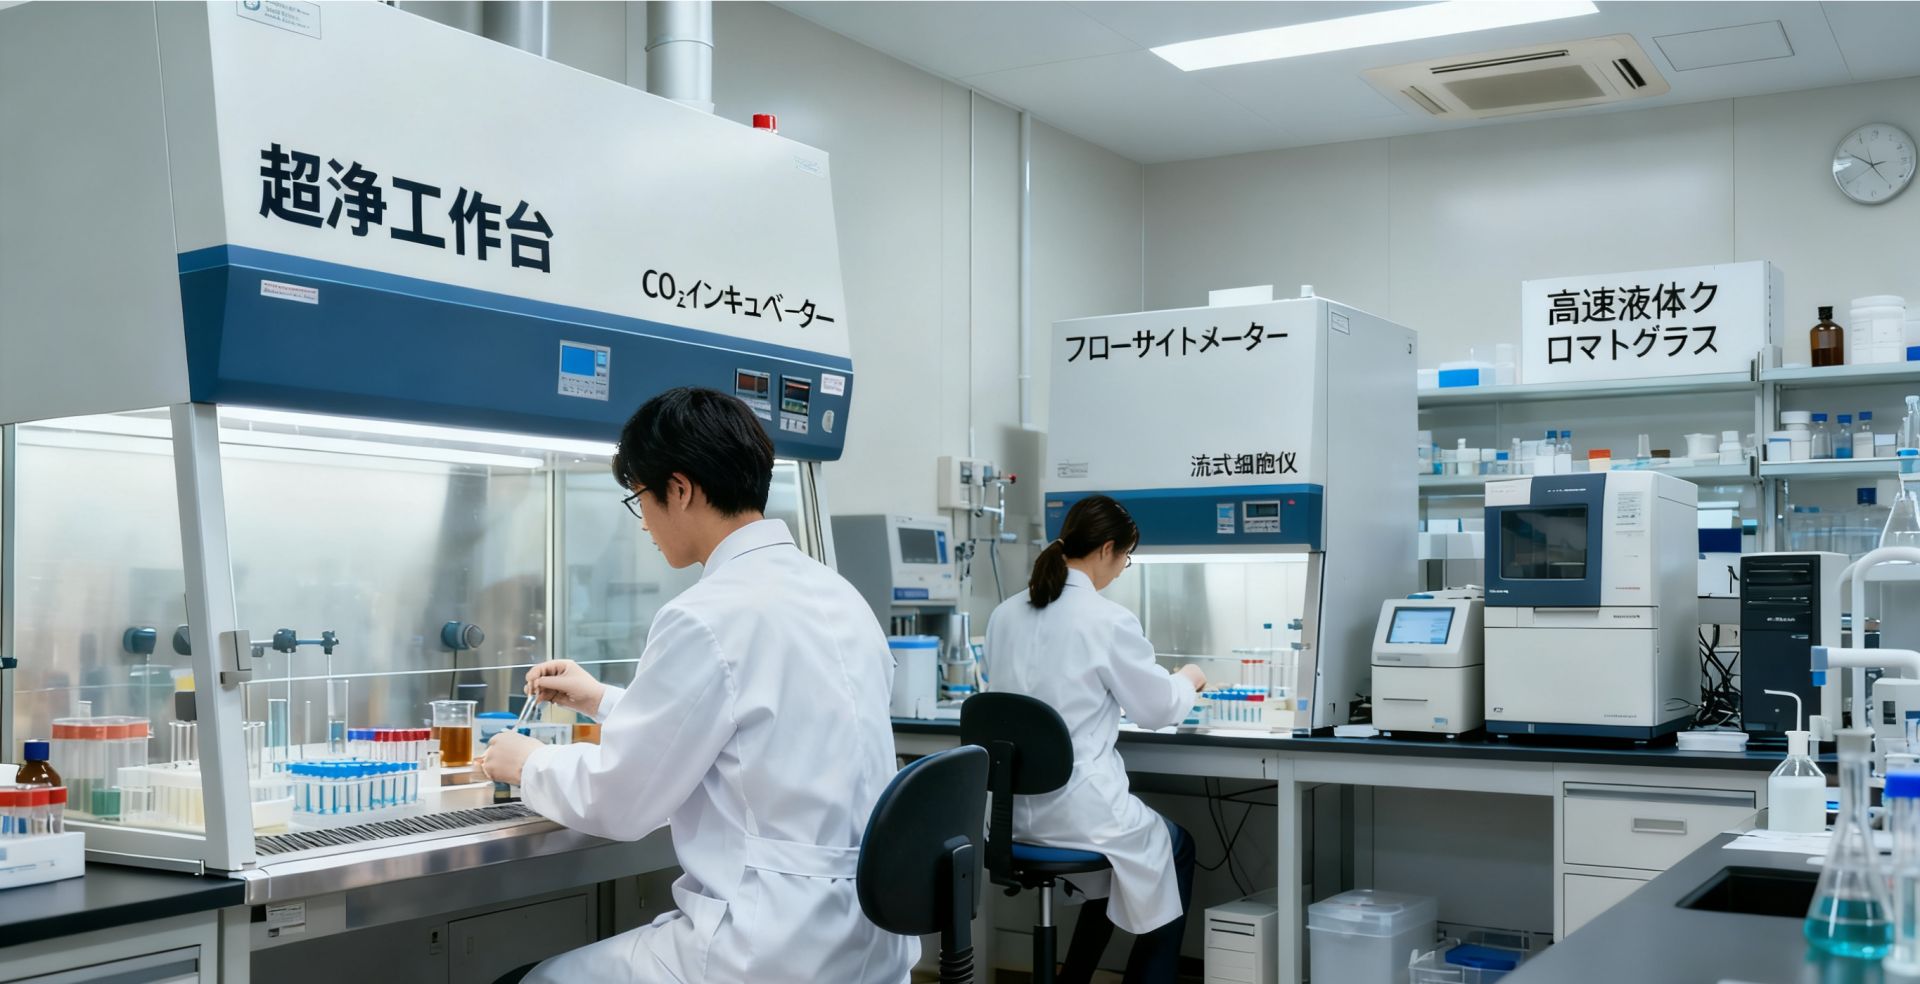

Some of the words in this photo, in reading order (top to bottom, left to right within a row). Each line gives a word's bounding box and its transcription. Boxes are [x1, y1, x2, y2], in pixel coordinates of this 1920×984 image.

[259, 142, 554, 274] 超浄工作台
[1547, 281, 1718, 325] 高速液体ク
[1066, 322, 1288, 363] フローサイトメーター
[1548, 325, 1718, 364] ロマトグラス
